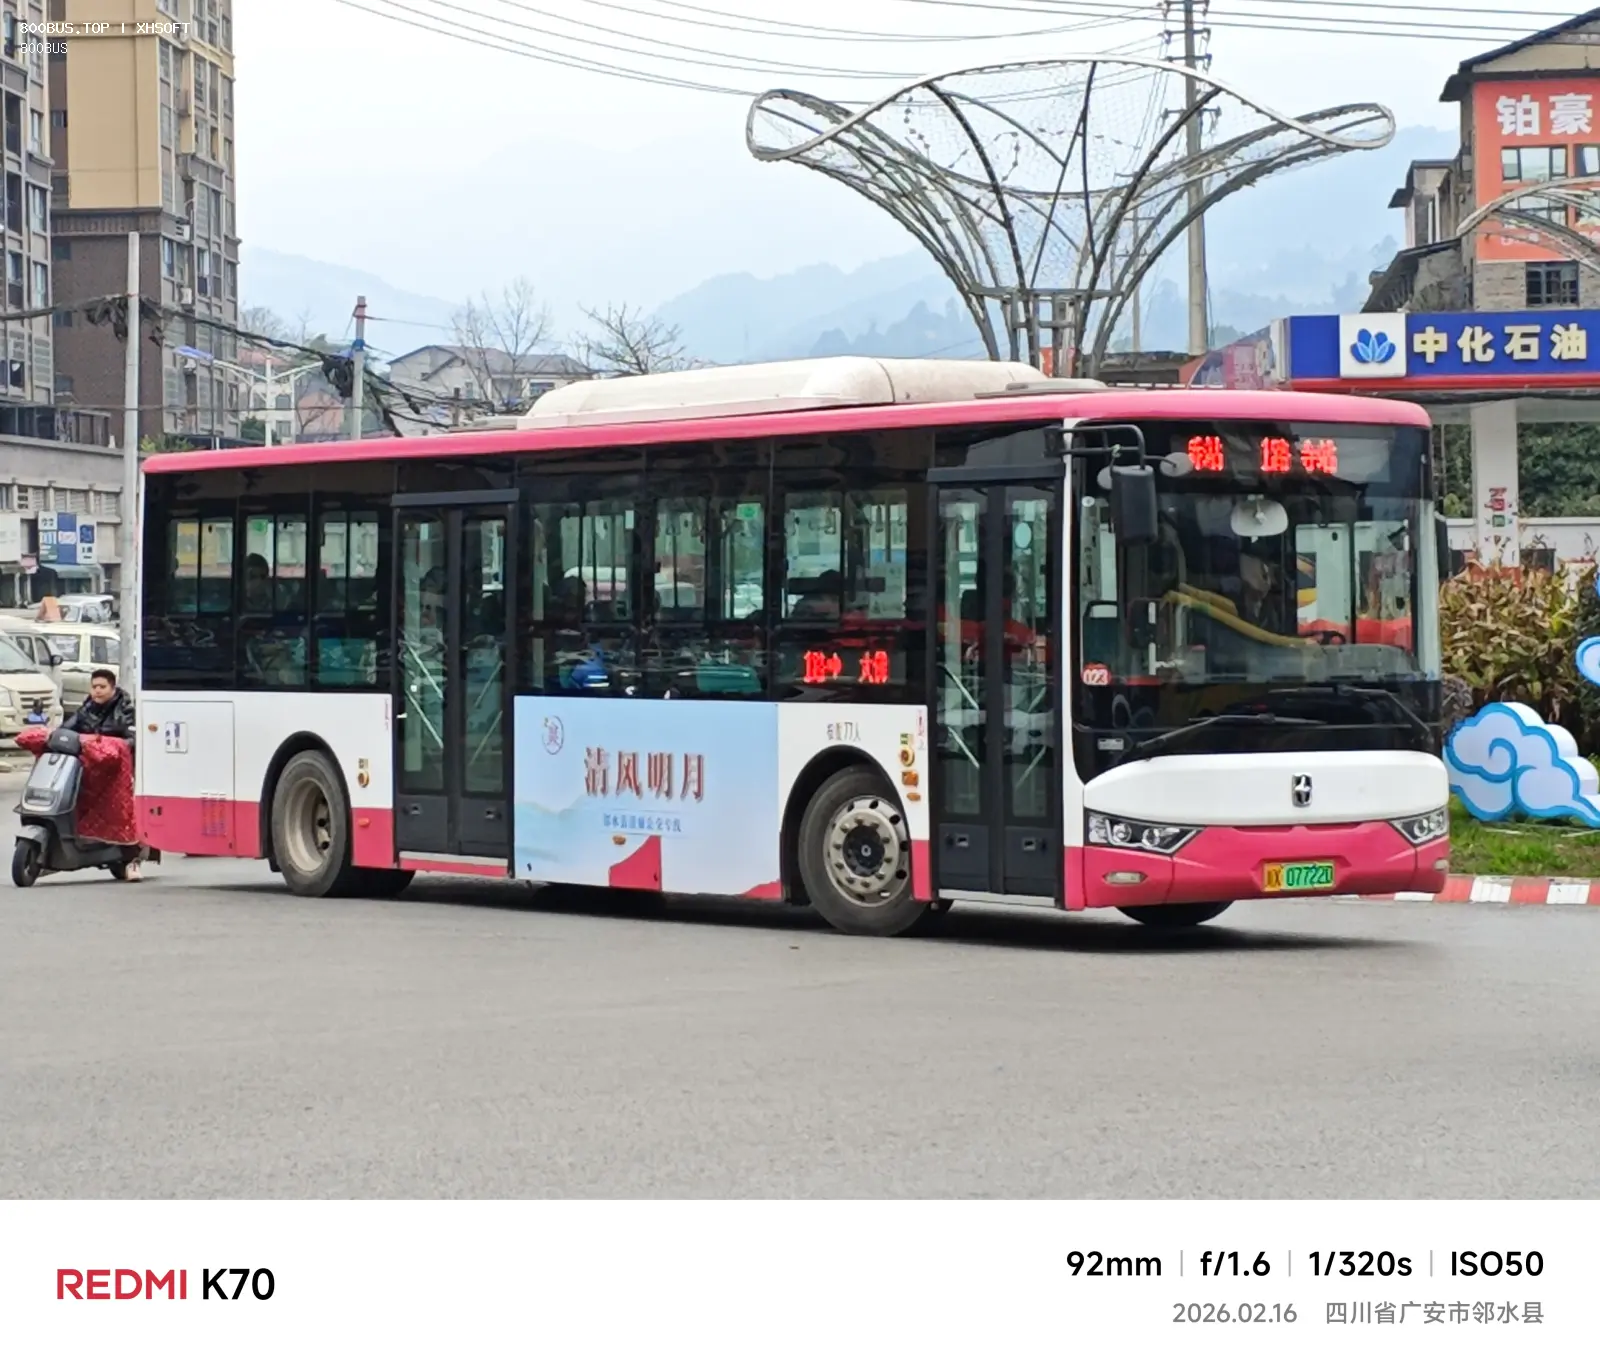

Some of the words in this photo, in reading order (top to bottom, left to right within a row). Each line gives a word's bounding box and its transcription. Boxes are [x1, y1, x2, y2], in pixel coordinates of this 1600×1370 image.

[1496, 92, 1593, 137] 铂豪
[1413, 323, 1587, 364] 中化石油
[584, 746, 705, 802] 清风明月
